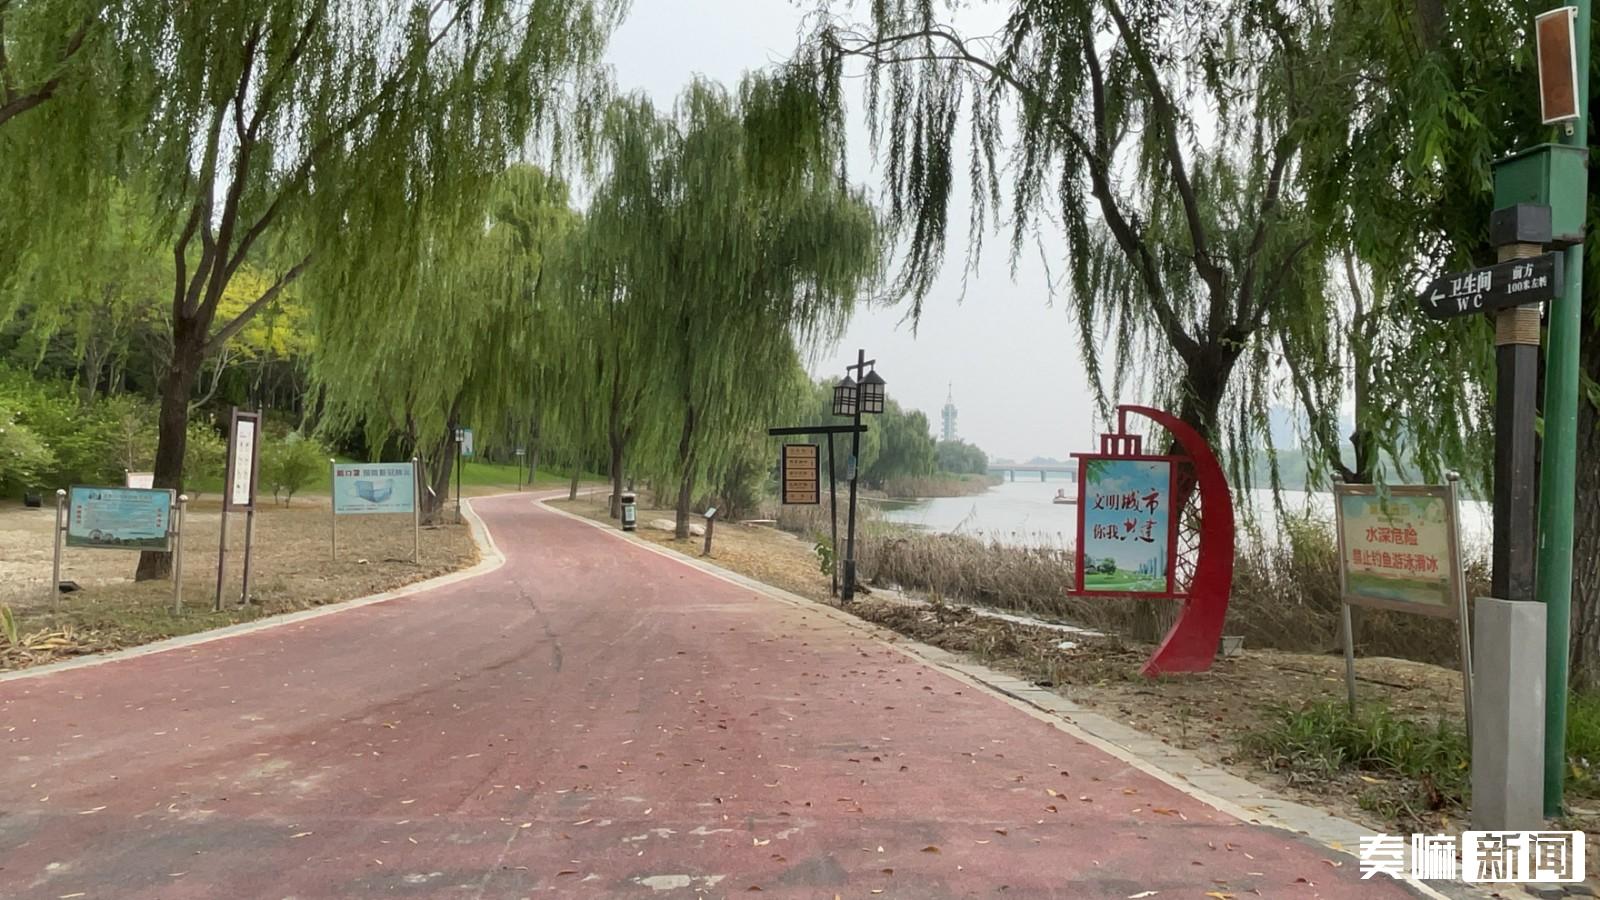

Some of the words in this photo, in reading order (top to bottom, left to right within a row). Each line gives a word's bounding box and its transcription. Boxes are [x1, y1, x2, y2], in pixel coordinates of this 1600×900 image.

[1449, 271, 1492, 297] 卫生间
[1512, 263, 1534, 280] 前方
[1092, 488, 1159, 515] 文明城市
[1093, 518, 1157, 543] 你我共建
[1366, 527, 1418, 546] 水深危险
